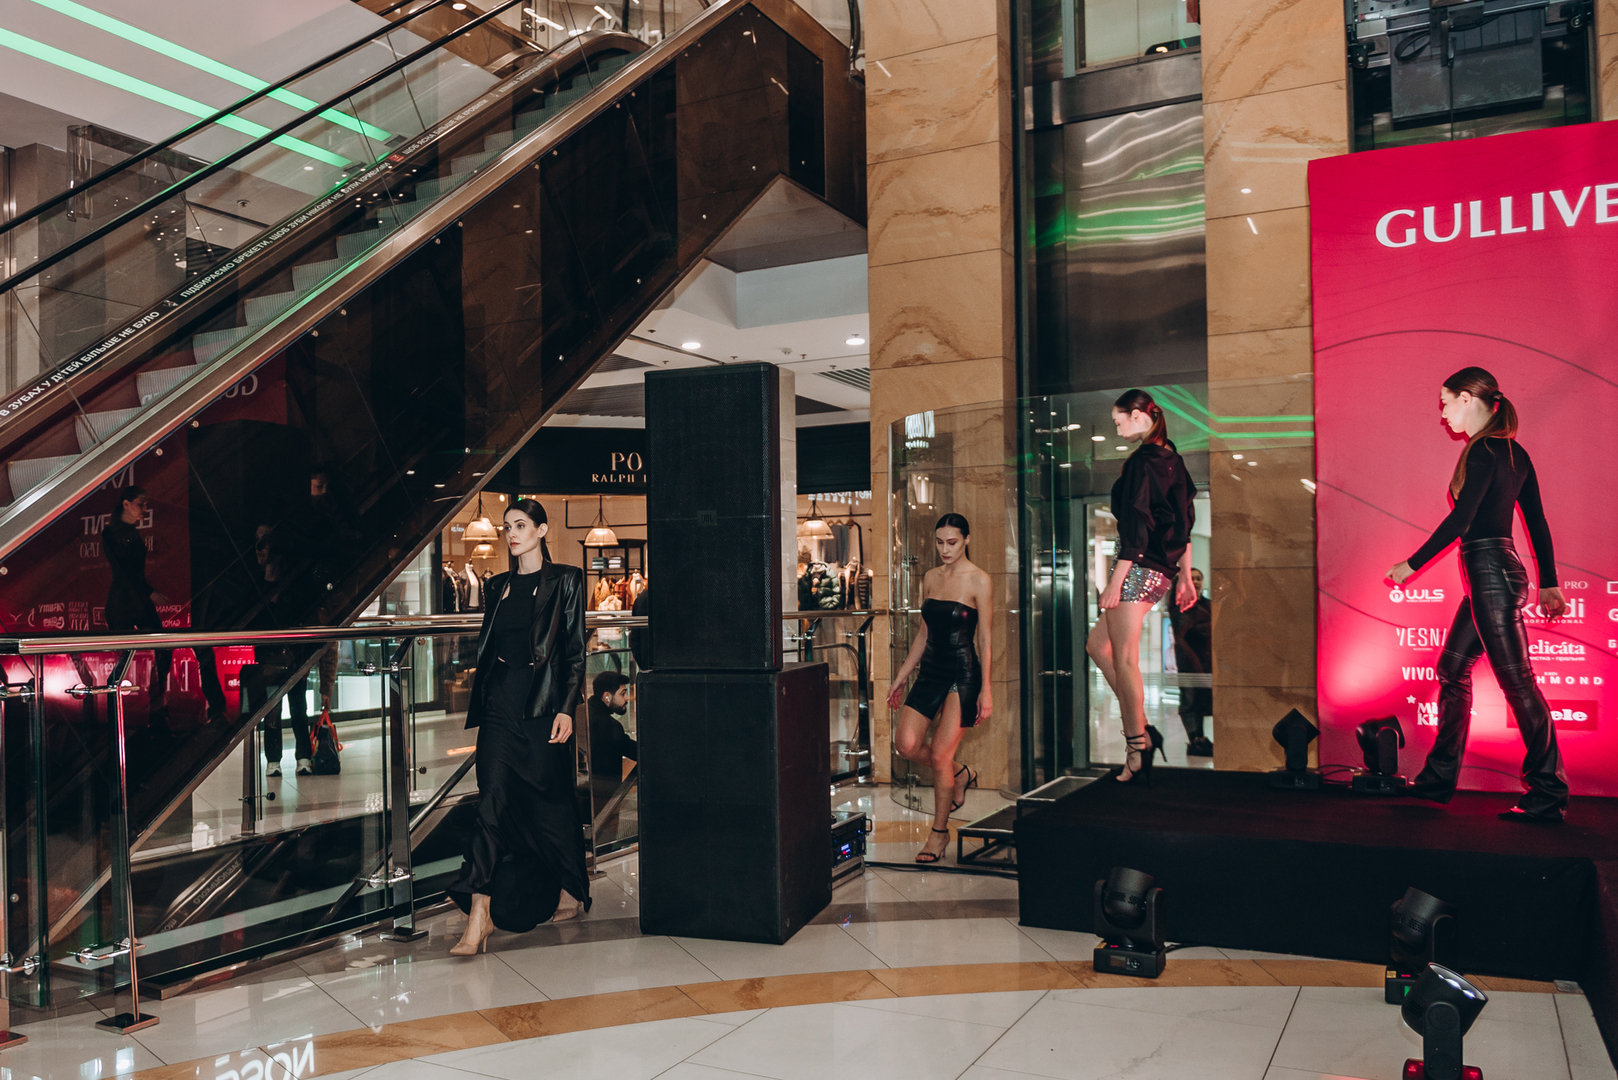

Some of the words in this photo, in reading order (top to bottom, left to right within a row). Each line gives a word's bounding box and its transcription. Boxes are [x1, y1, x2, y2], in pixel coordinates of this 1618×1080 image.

[402, 142, 419, 155] ЩОБ
[1375, 182, 1618, 248] GULLIVE
[180, 262, 235, 298] ПІДБИРАЄМО
[270, 225, 290, 241] ЩОБ
[287, 214, 308, 230] ЗУБИ
[306, 199, 333, 218] НІКОЛИ
[329, 191, 345, 202] НЕ
[342, 180, 361, 194] БУЛИ
[8, 385, 45, 410] ЗУБАХ
[42, 380, 52, 388] У
[51, 361, 83, 383] ДІТЕЙ
[80, 336, 122, 363] БІЛЬШЕ
[119, 327, 136, 338] НЕ
[133, 311, 160, 329] БУЛО
[611, 452, 643, 471] PO
[591, 473, 635, 483] RALPH
[701, 514, 714, 522] JBL
[1564, 581, 1588, 590] PRO
[1405, 589, 1445, 600] WLS
[1528, 639, 1586, 655] elicáta
[1401, 666, 1439, 681] VIVO
[1536, 676, 1604, 685] HMOND
[1550, 708, 1588, 722] ele
